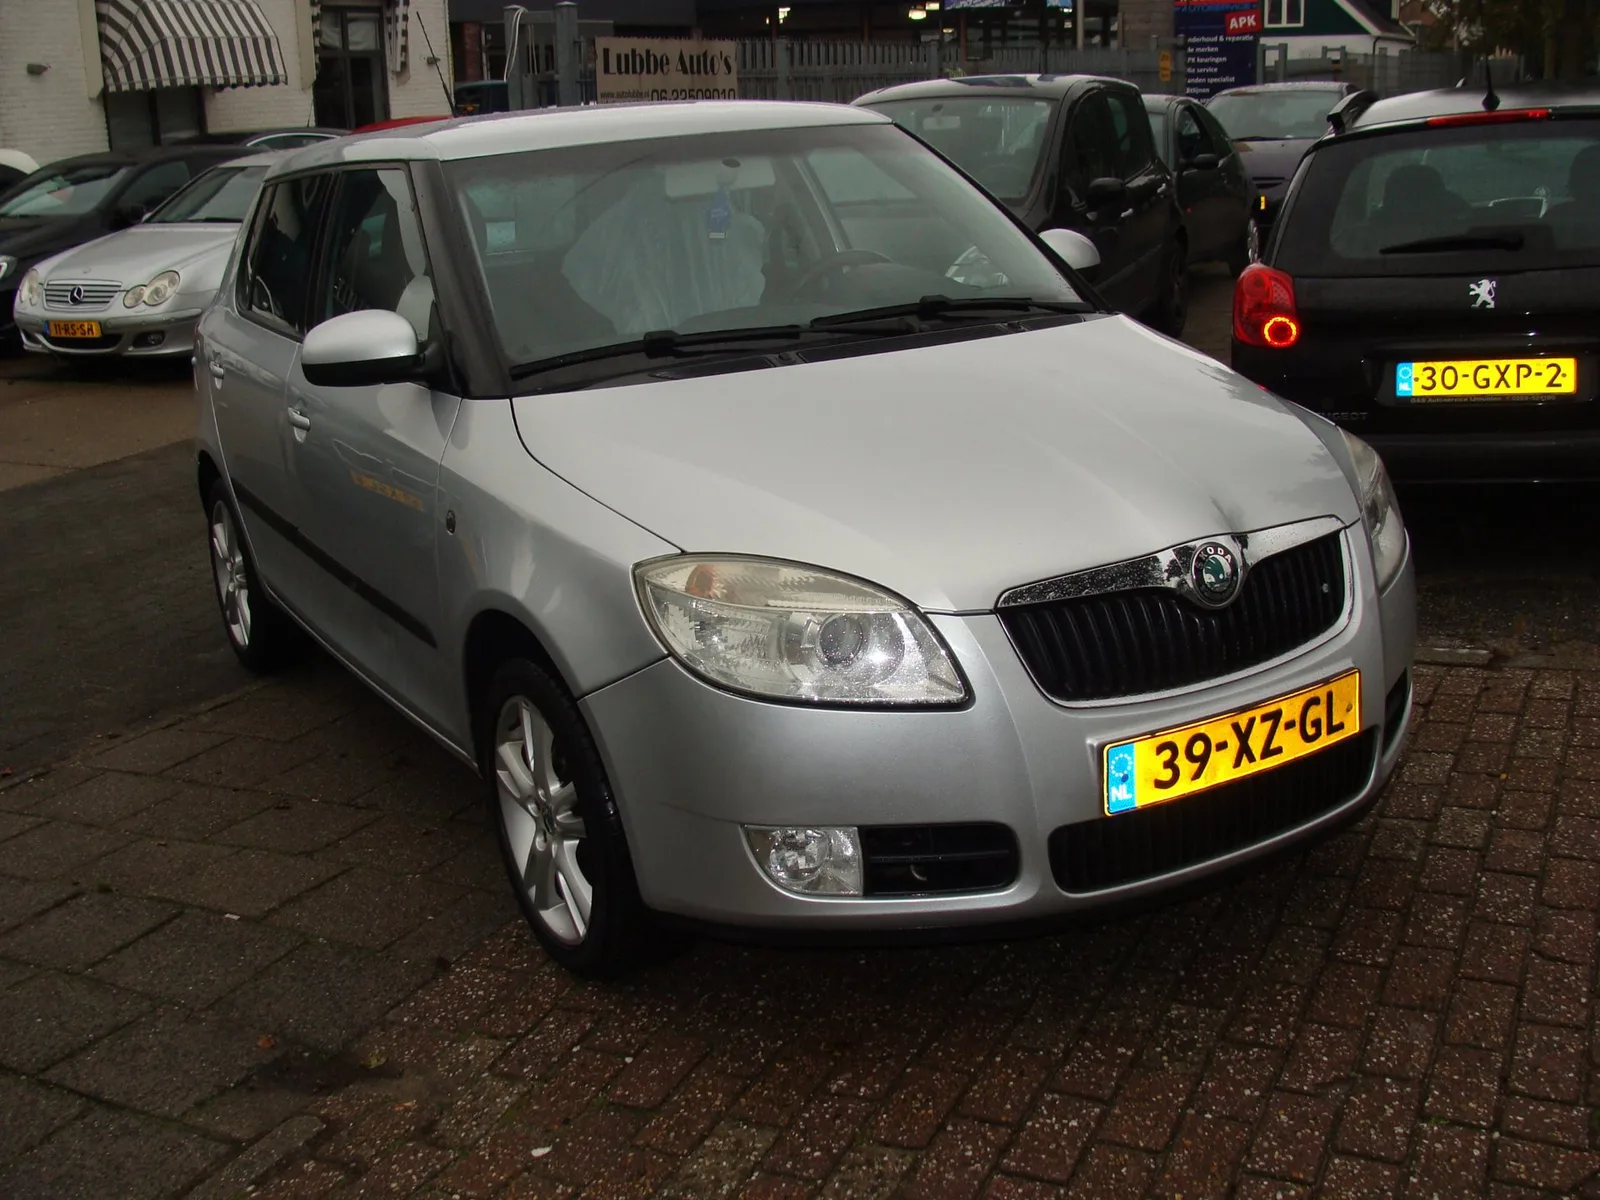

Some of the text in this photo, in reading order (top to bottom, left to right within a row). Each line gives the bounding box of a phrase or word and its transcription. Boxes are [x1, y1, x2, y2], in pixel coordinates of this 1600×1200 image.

[1229, 14, 1256, 30] APK
[1187, 34, 1217, 43] nderhoud
[603, 48, 733, 76] Lubbe Auto's
[1196, 56, 1227, 64] keuringen
[1207, 76, 1235, 84] specialist
[54, 323, 94, 337] 11-RS-SH
[1420, 363, 1563, 390] 30-GXP-2
[1110, 690, 1345, 802] NL 39-XZ-GL
